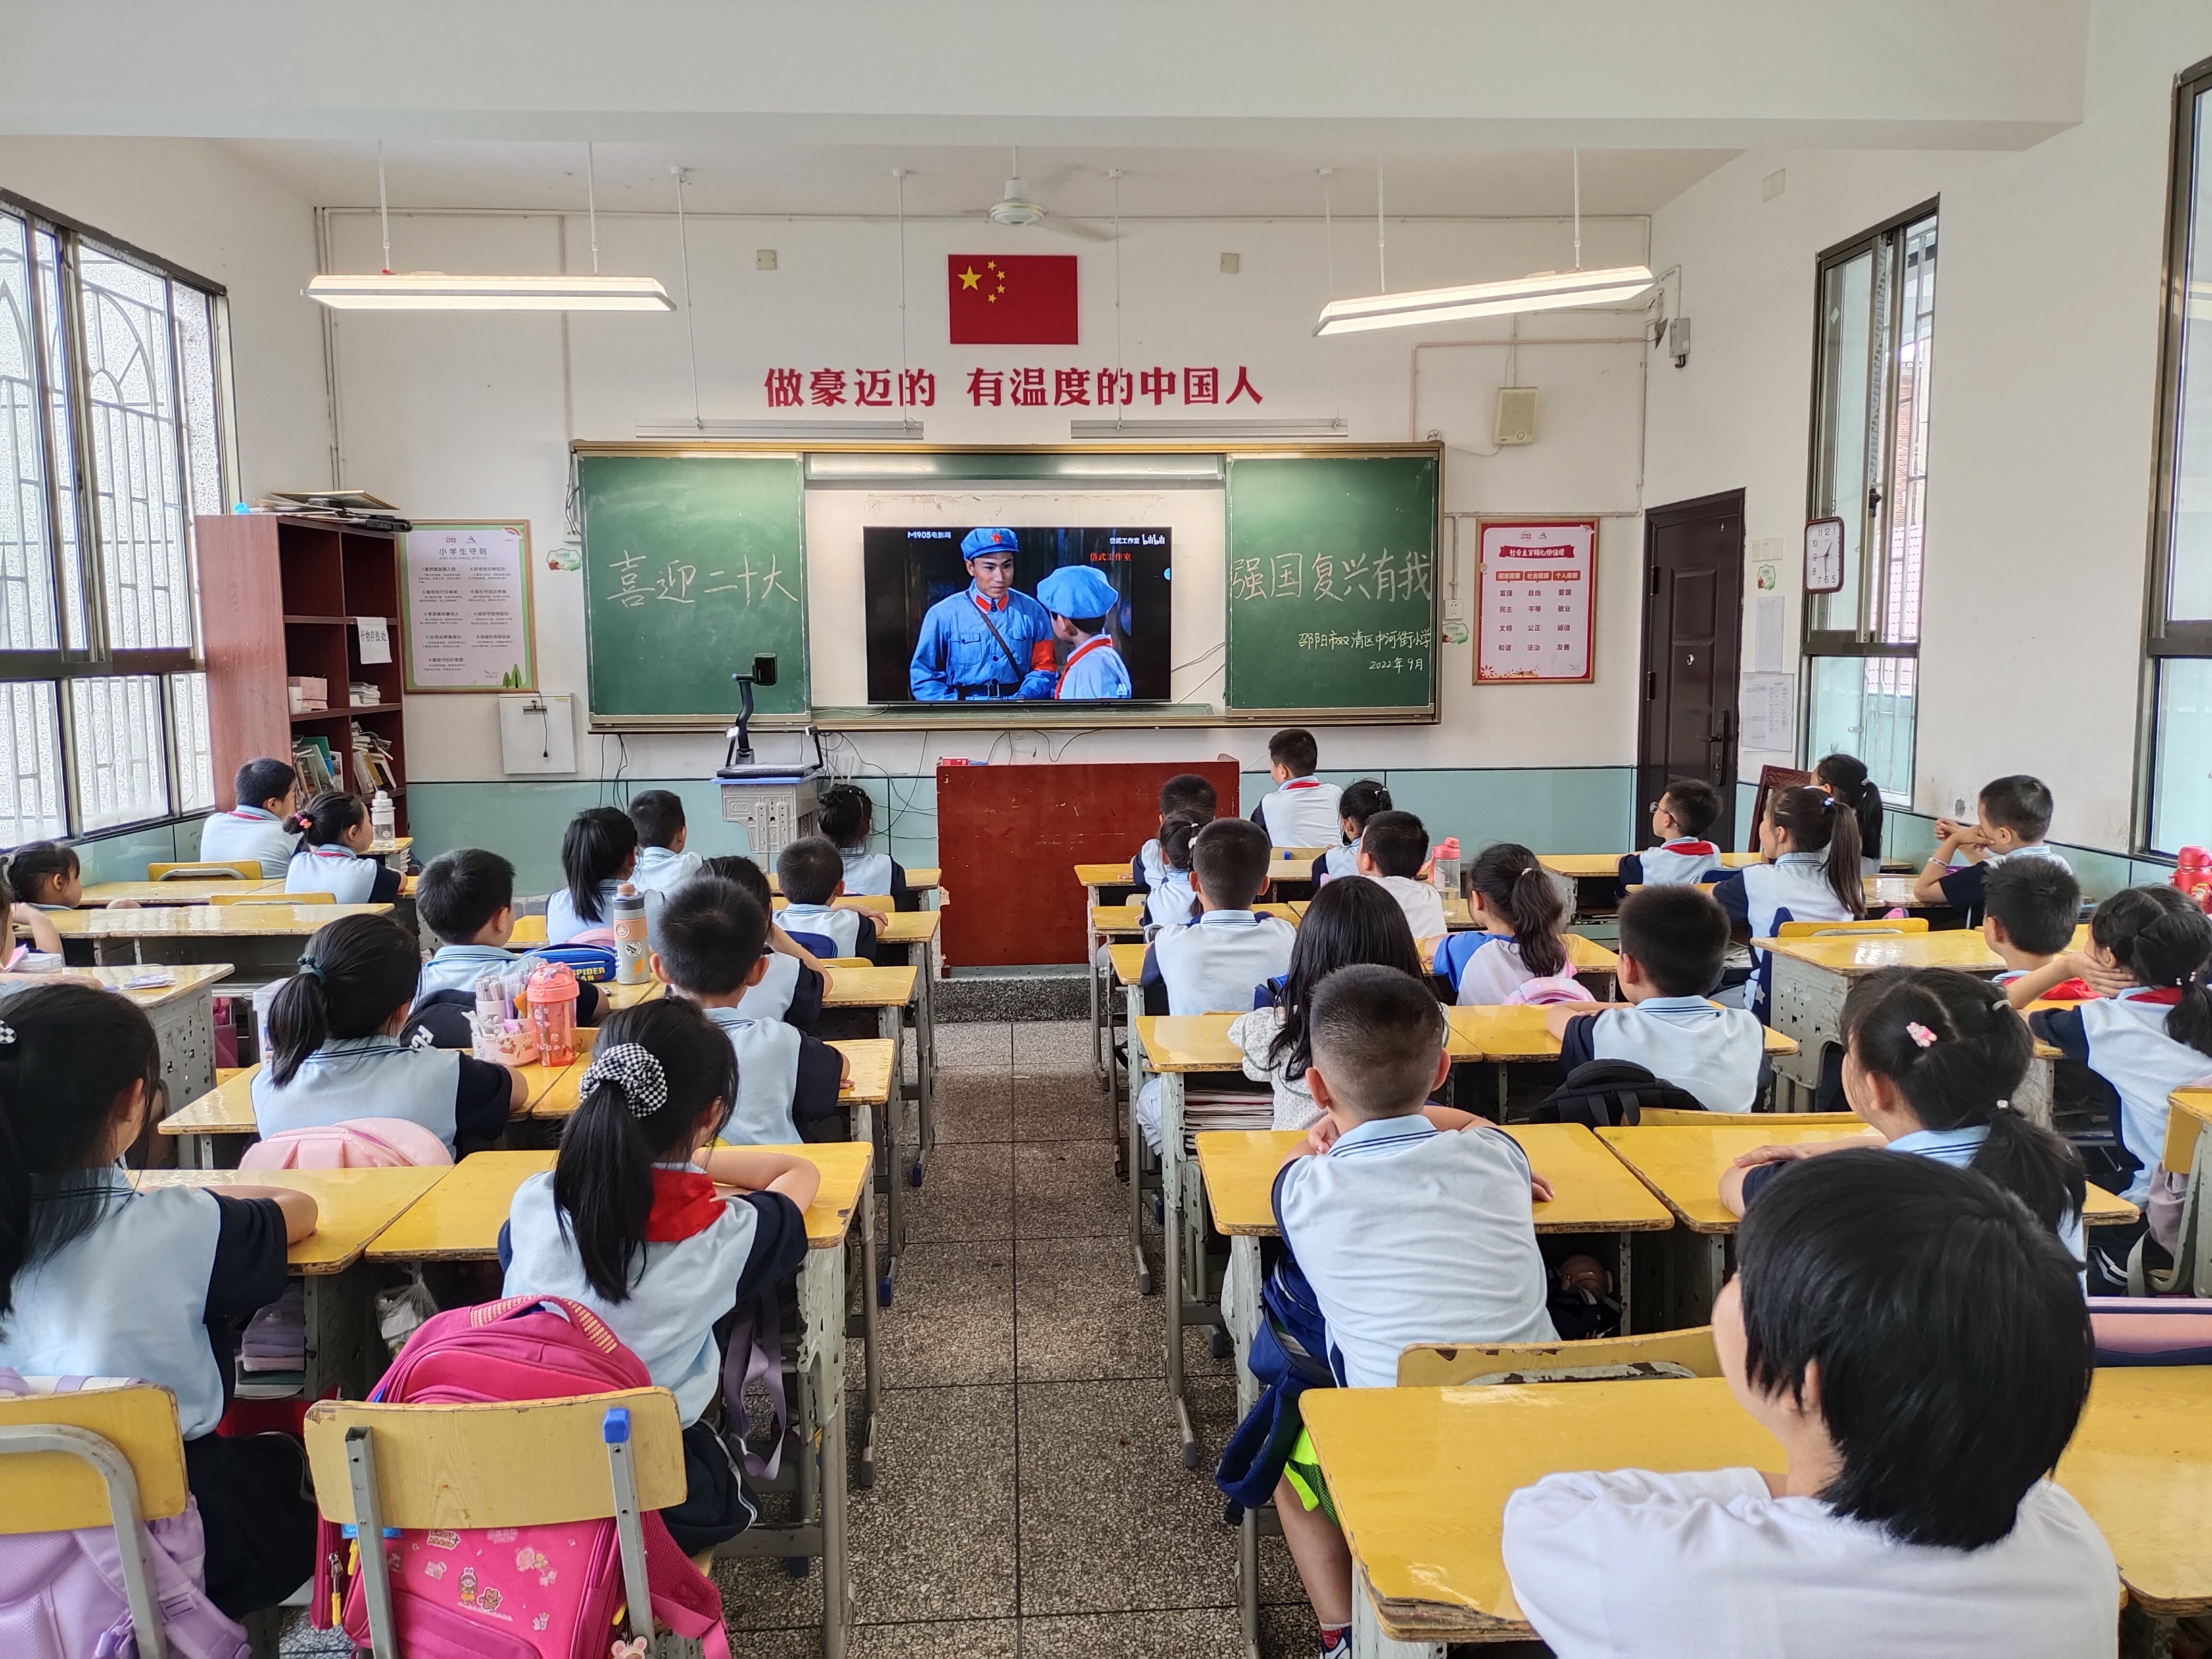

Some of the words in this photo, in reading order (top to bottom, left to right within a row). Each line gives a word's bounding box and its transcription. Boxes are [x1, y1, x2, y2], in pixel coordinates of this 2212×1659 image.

[764, 367, 935, 407] 做豪迈的
[966, 365, 1263, 407] 有温度的中国人
[1825, 528, 1830, 536] 12
[1813, 539, 1818, 547] 10
[439, 547, 487, 555] 小学生守则
[1509, 548, 1565, 556] 社会主义核心价值观
[1232, 547, 1431, 602] 强国复兴有我
[1812, 567, 1816, 576] 8
[606, 549, 798, 608] 喜迎二十大
[1817, 577, 1822, 585] 7
[1825, 576, 1829, 584] 6
[1831, 575, 1836, 583] 5
[1298, 627, 1431, 651] 邵阳市双清区中河街小学
